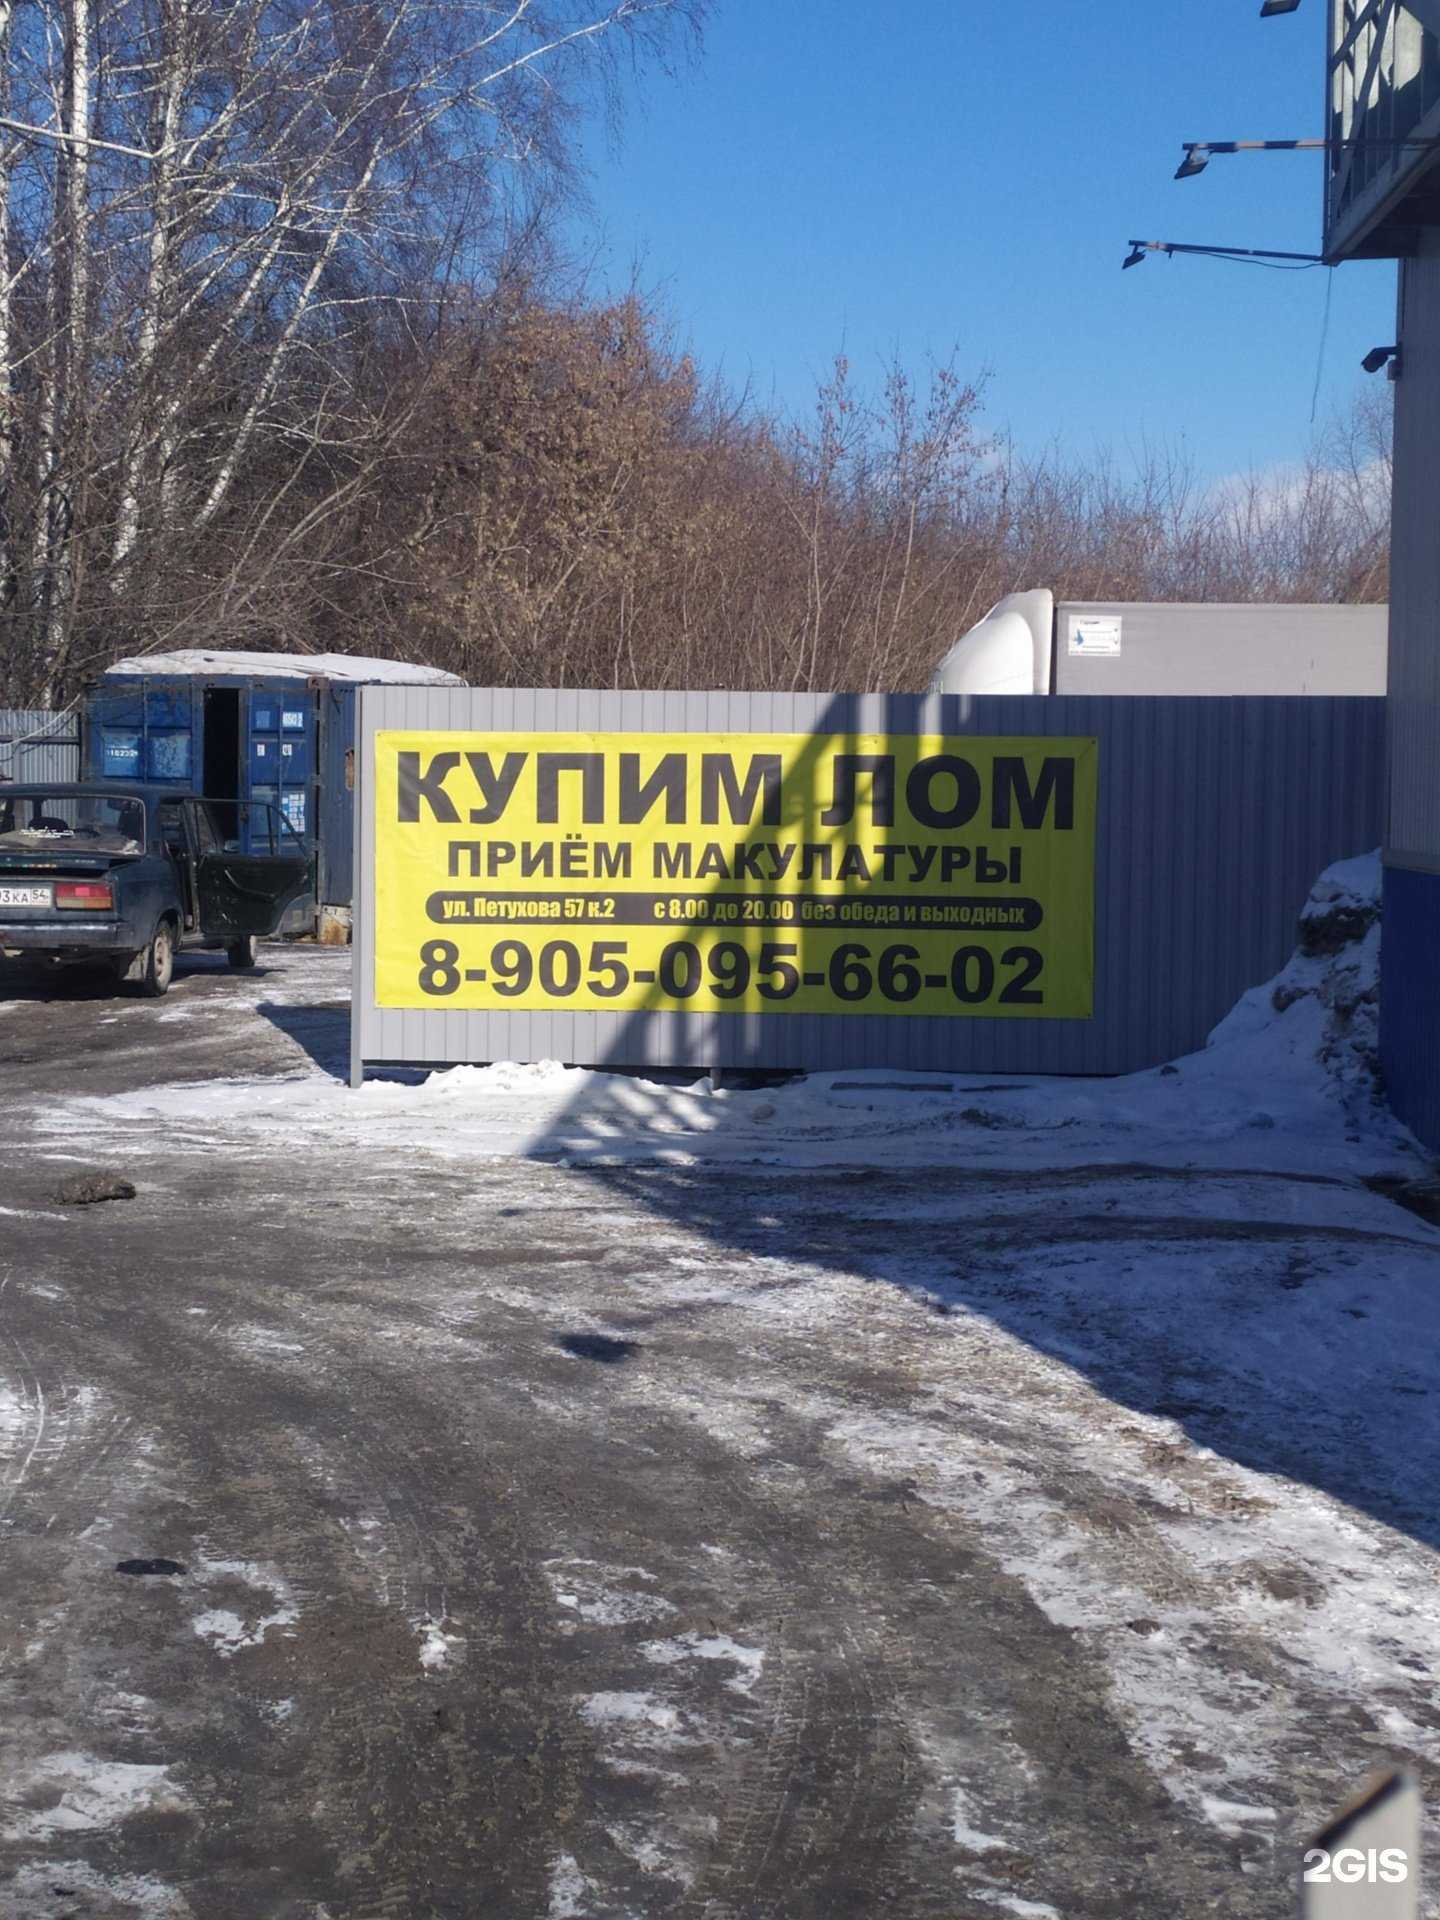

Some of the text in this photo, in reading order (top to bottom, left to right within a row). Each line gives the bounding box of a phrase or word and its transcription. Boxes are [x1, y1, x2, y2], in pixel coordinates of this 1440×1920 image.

[397, 751, 1076, 830] КУПИМ ЛОМ
[447, 833, 1022, 884] ПРИЁМ МАКУЛАТУРЫ
[442, 897, 1025, 926] ул. Петухова 57 к.2 с 8.00 до 20.00 без обеда и выходных
[418, 939, 1044, 1005] 8-905-095-66-02
